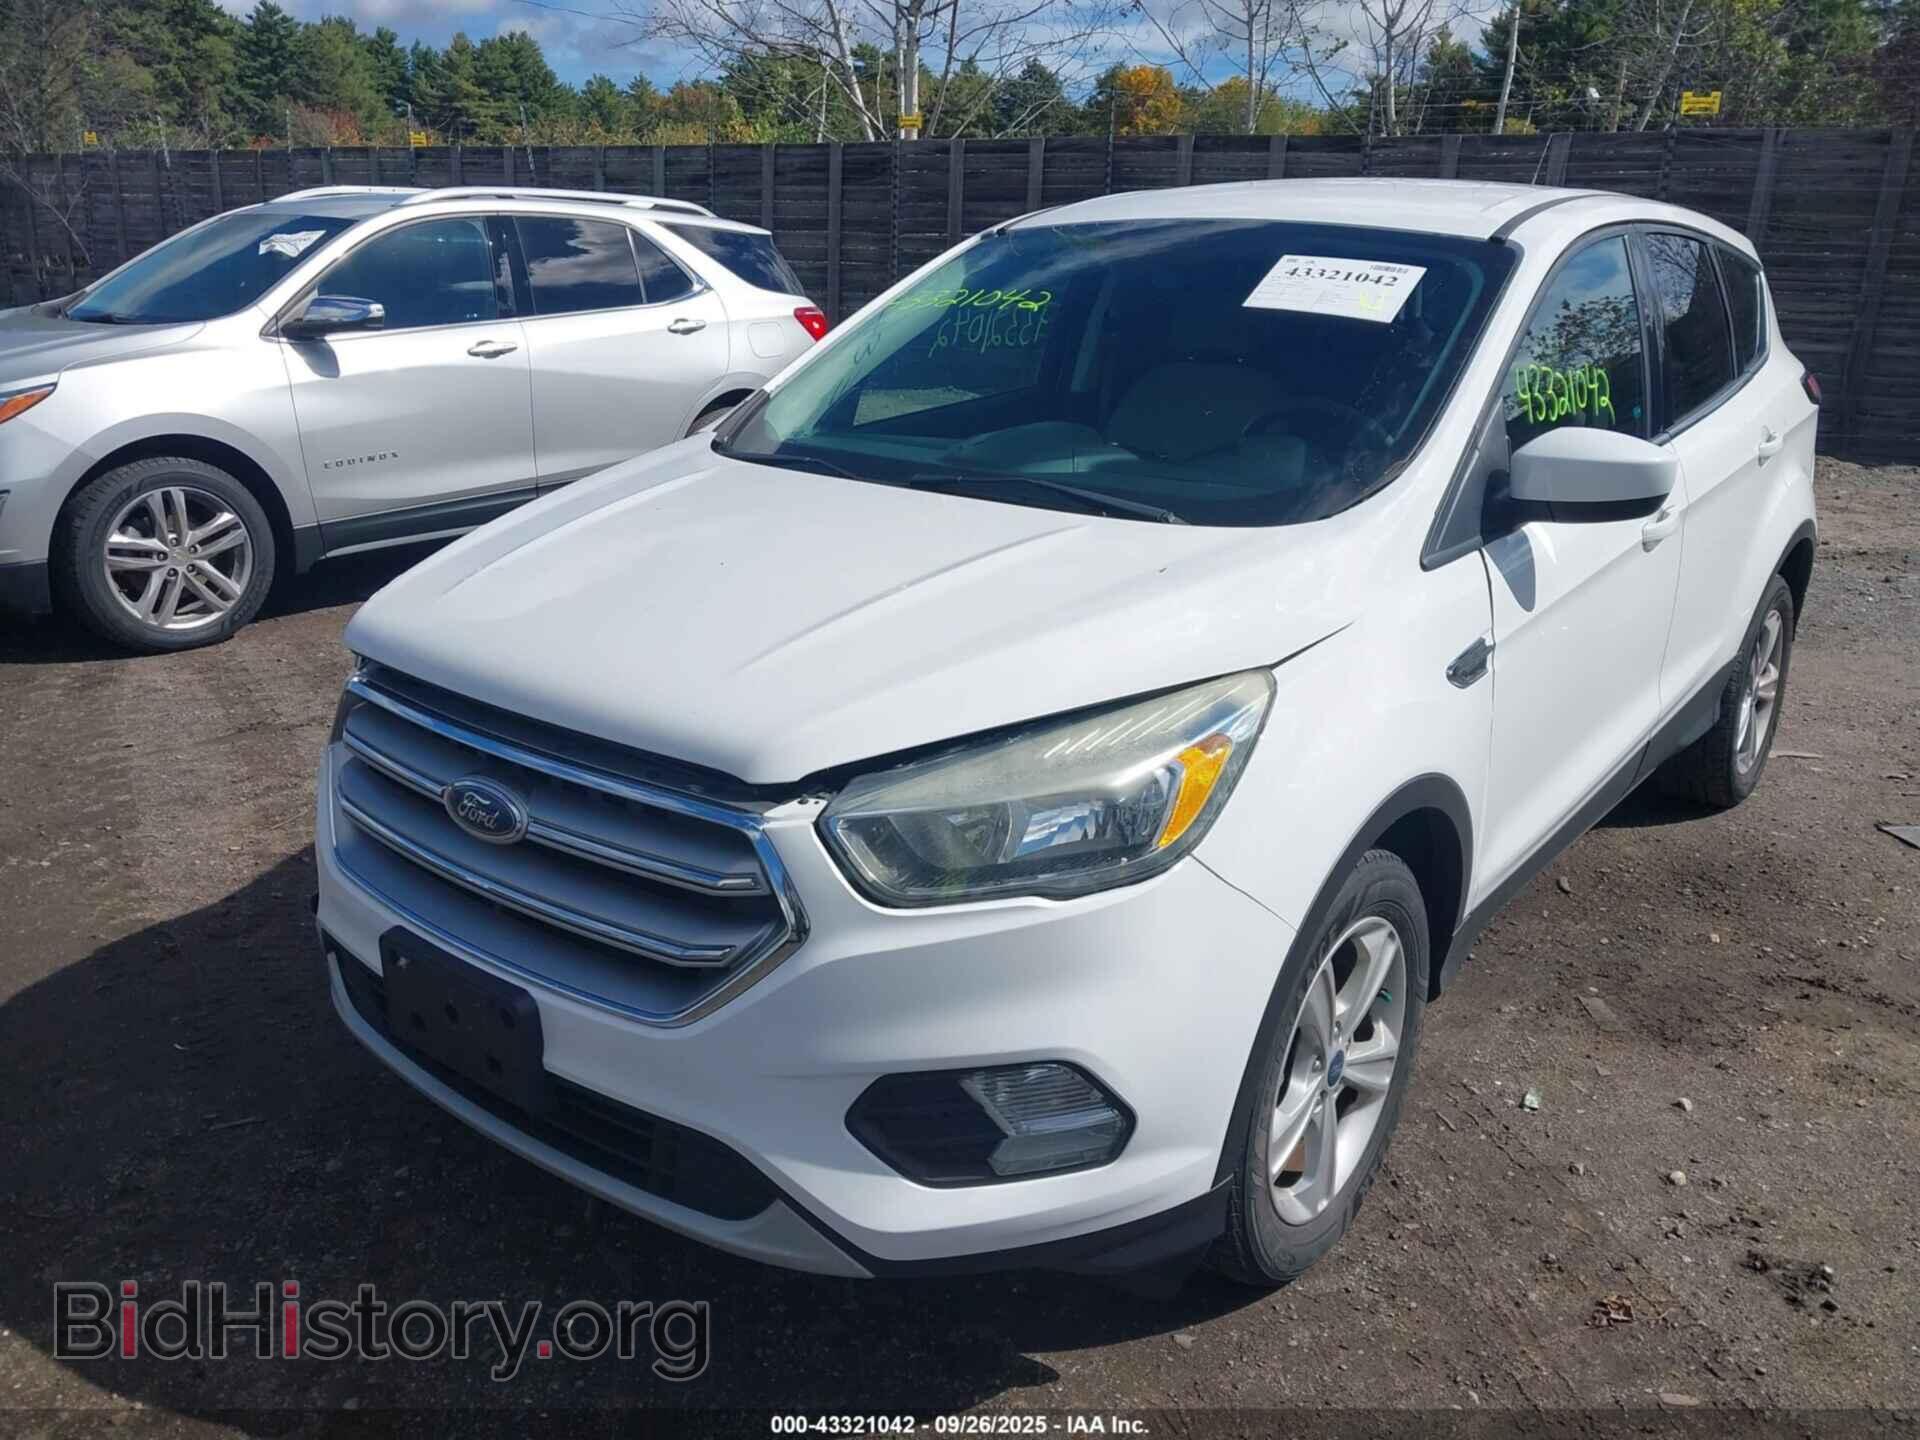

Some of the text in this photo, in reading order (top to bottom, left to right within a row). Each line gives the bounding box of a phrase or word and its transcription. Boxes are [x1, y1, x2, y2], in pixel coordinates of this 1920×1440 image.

[1285, 265, 1399, 287] 43321042
[1515, 362, 1616, 425] 43321042
[457, 791, 500, 830] Ford
